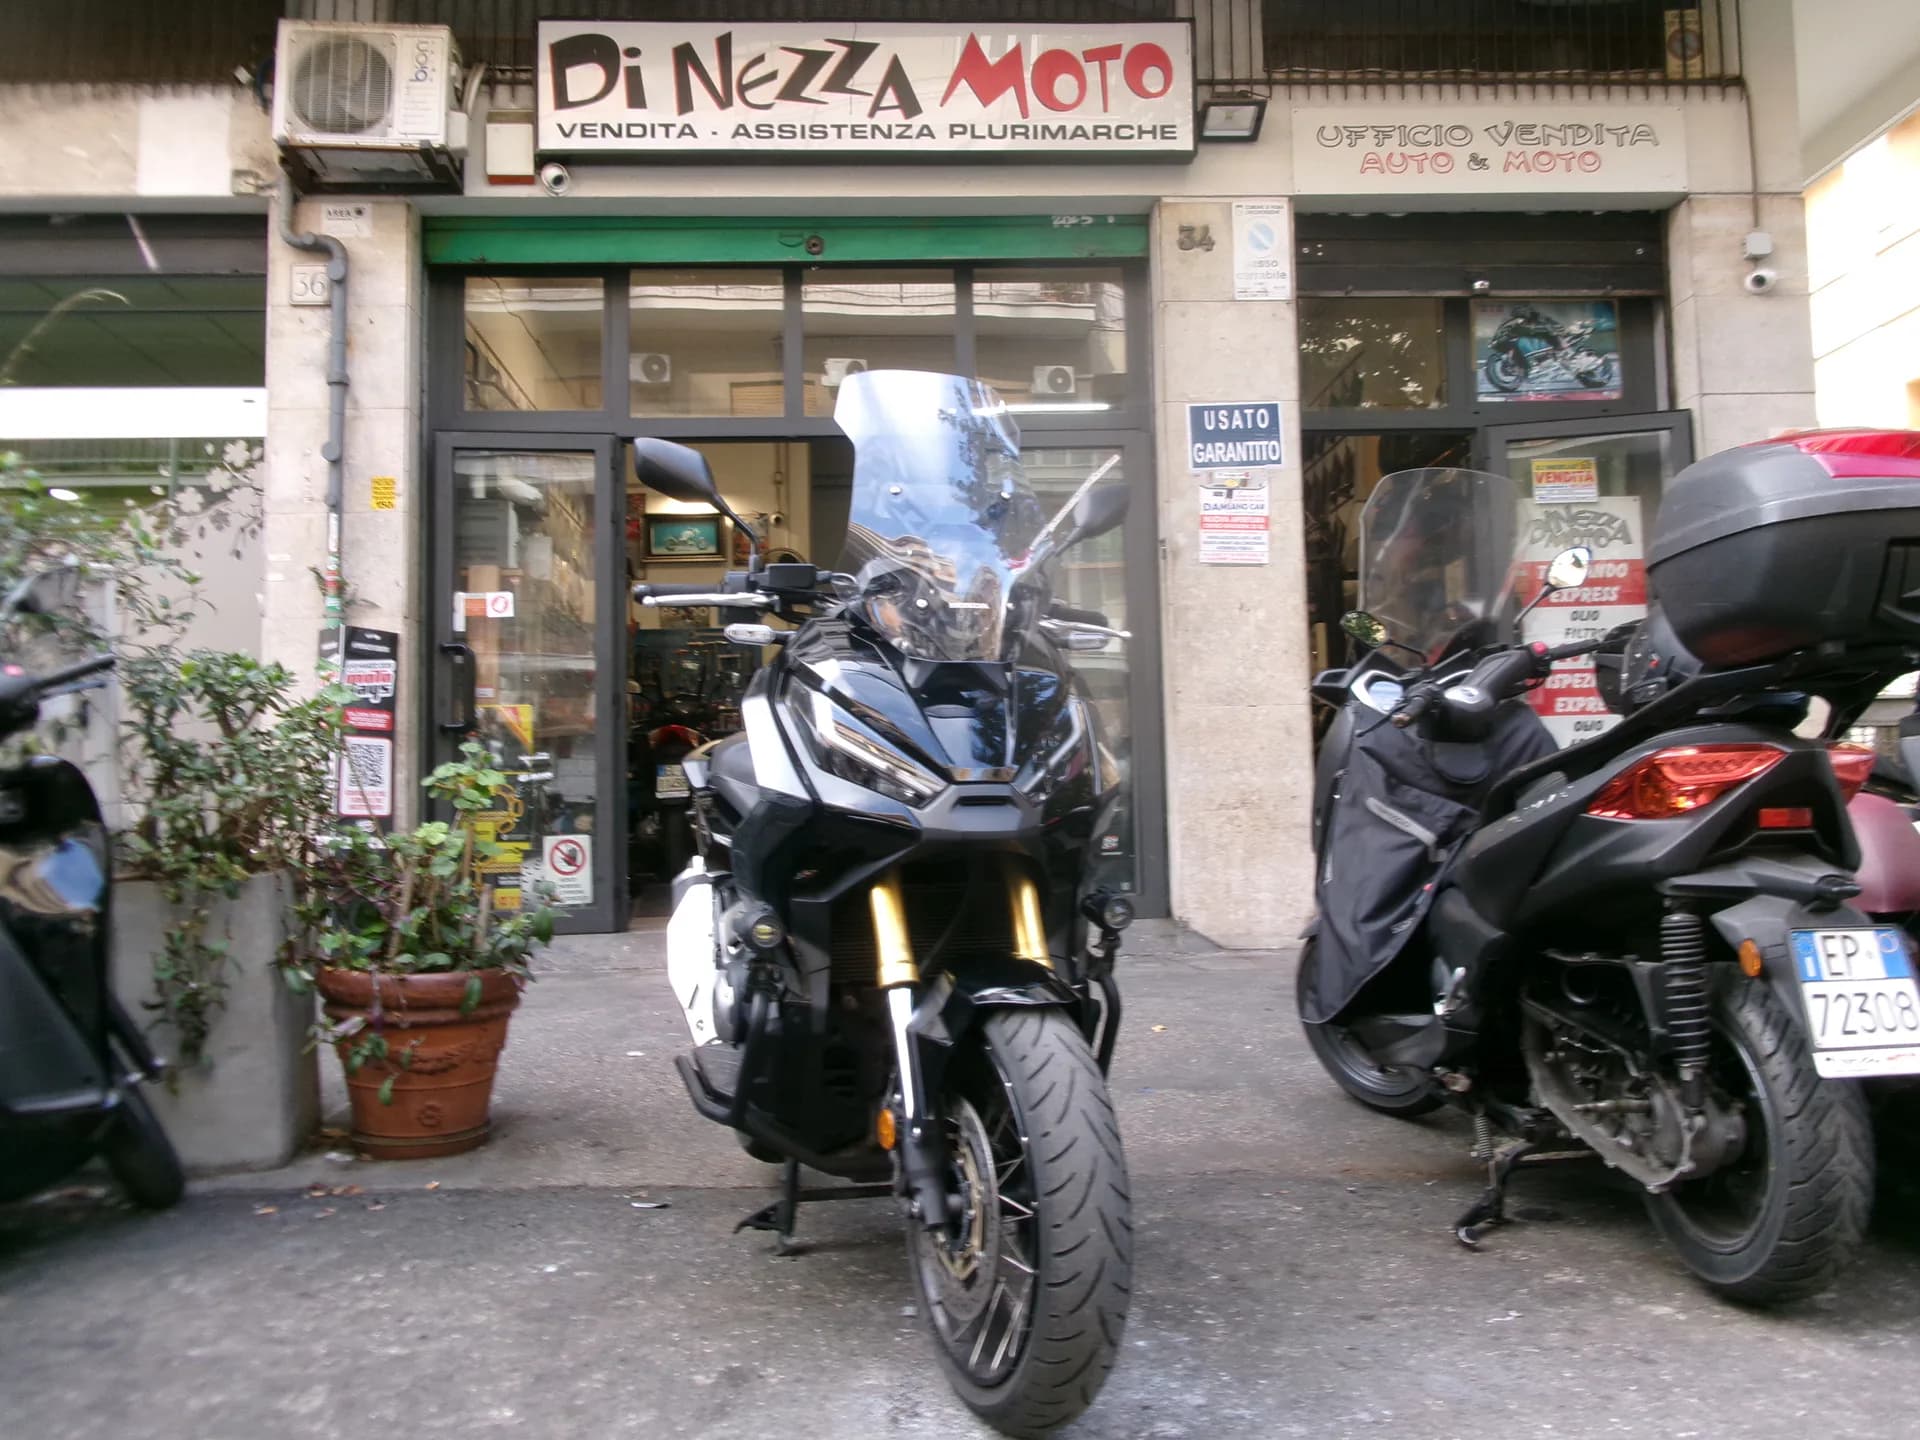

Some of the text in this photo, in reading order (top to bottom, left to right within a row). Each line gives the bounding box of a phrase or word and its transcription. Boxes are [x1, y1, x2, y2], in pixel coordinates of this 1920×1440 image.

[939, 31, 1173, 119] MOTO
[556, 122, 699, 139] VENDITA
[731, 122, 937, 140] ASSISTENZA
[949, 123, 1178, 140] PLURIMARCHE
[1316, 120, 1661, 148] UFFICIO VENDITA
[1360, 150, 1601, 174] AUTO & MOTO
[1177, 224, 1215, 252] 34
[293, 272, 327, 297] 36
[1203, 408, 1269, 431] USATO
[1193, 440, 1280, 463] GARANTITO
[1570, 609, 1600, 622] OLIO
[1821, 934, 1859, 977] EP
[1811, 990, 1920, 1038] 72308
